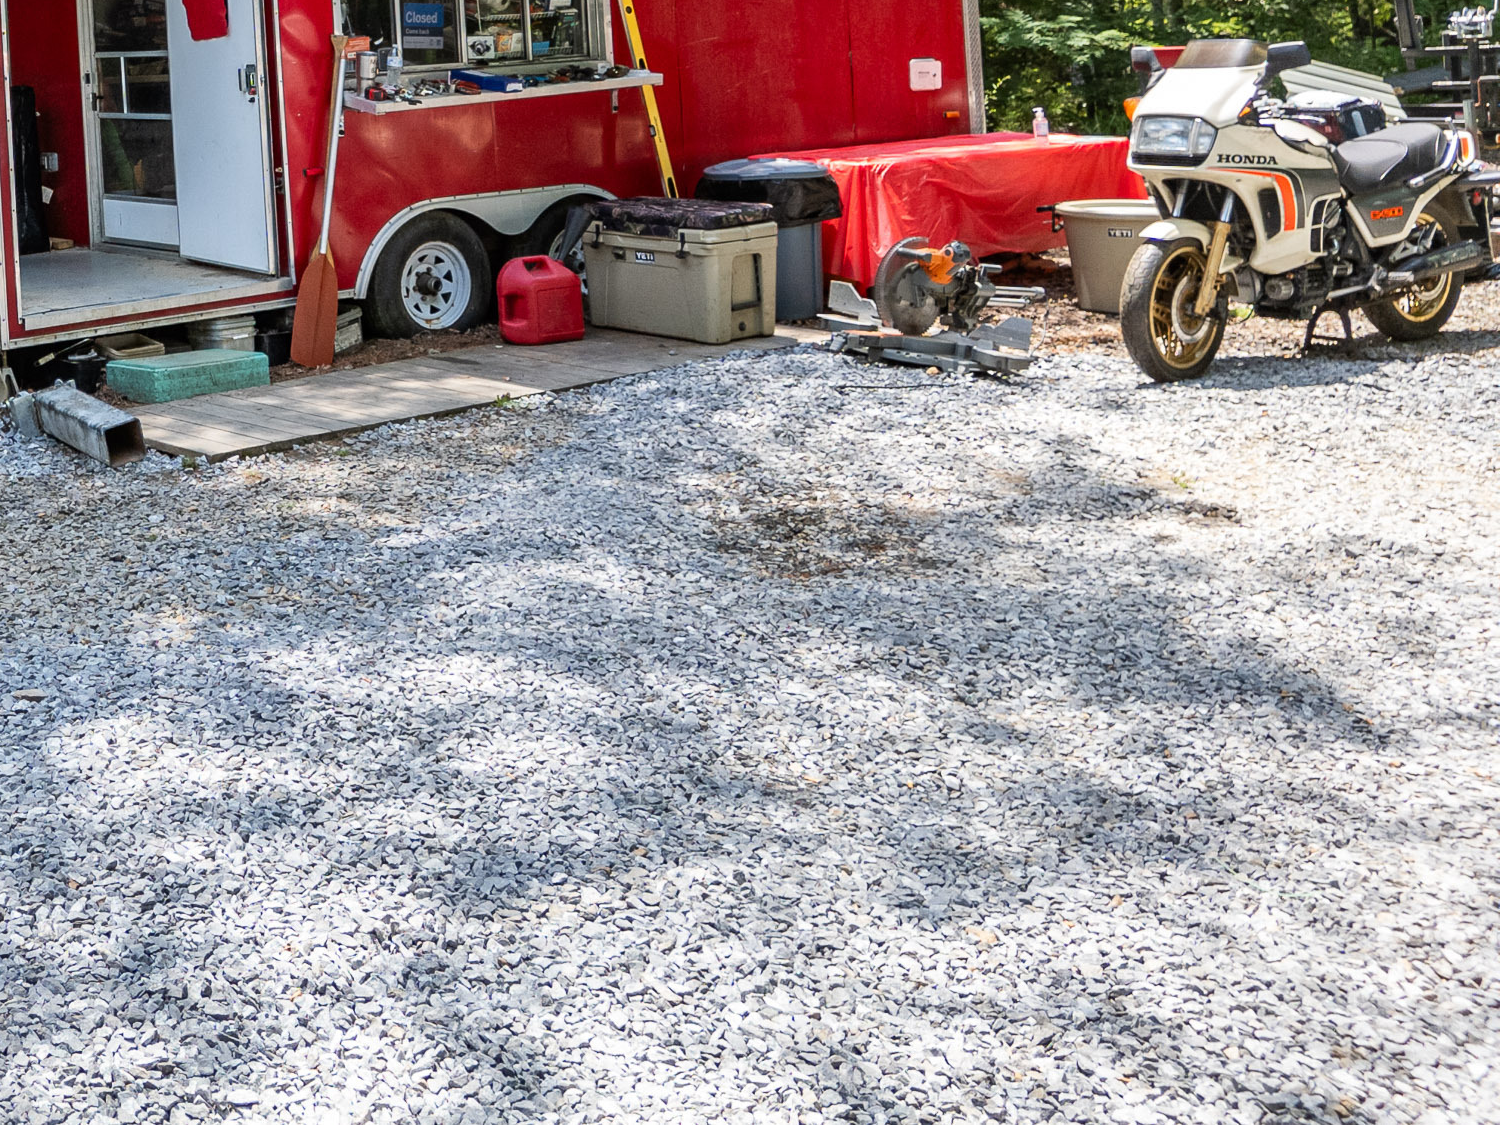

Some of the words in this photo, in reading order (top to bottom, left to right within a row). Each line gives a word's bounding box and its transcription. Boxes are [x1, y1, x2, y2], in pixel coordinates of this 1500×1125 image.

[405, 10, 438, 24] Closed
[1217, 154, 1278, 165] HONDA
[1108, 228, 1132, 237] YETI
[636, 251, 654, 260] YETI
